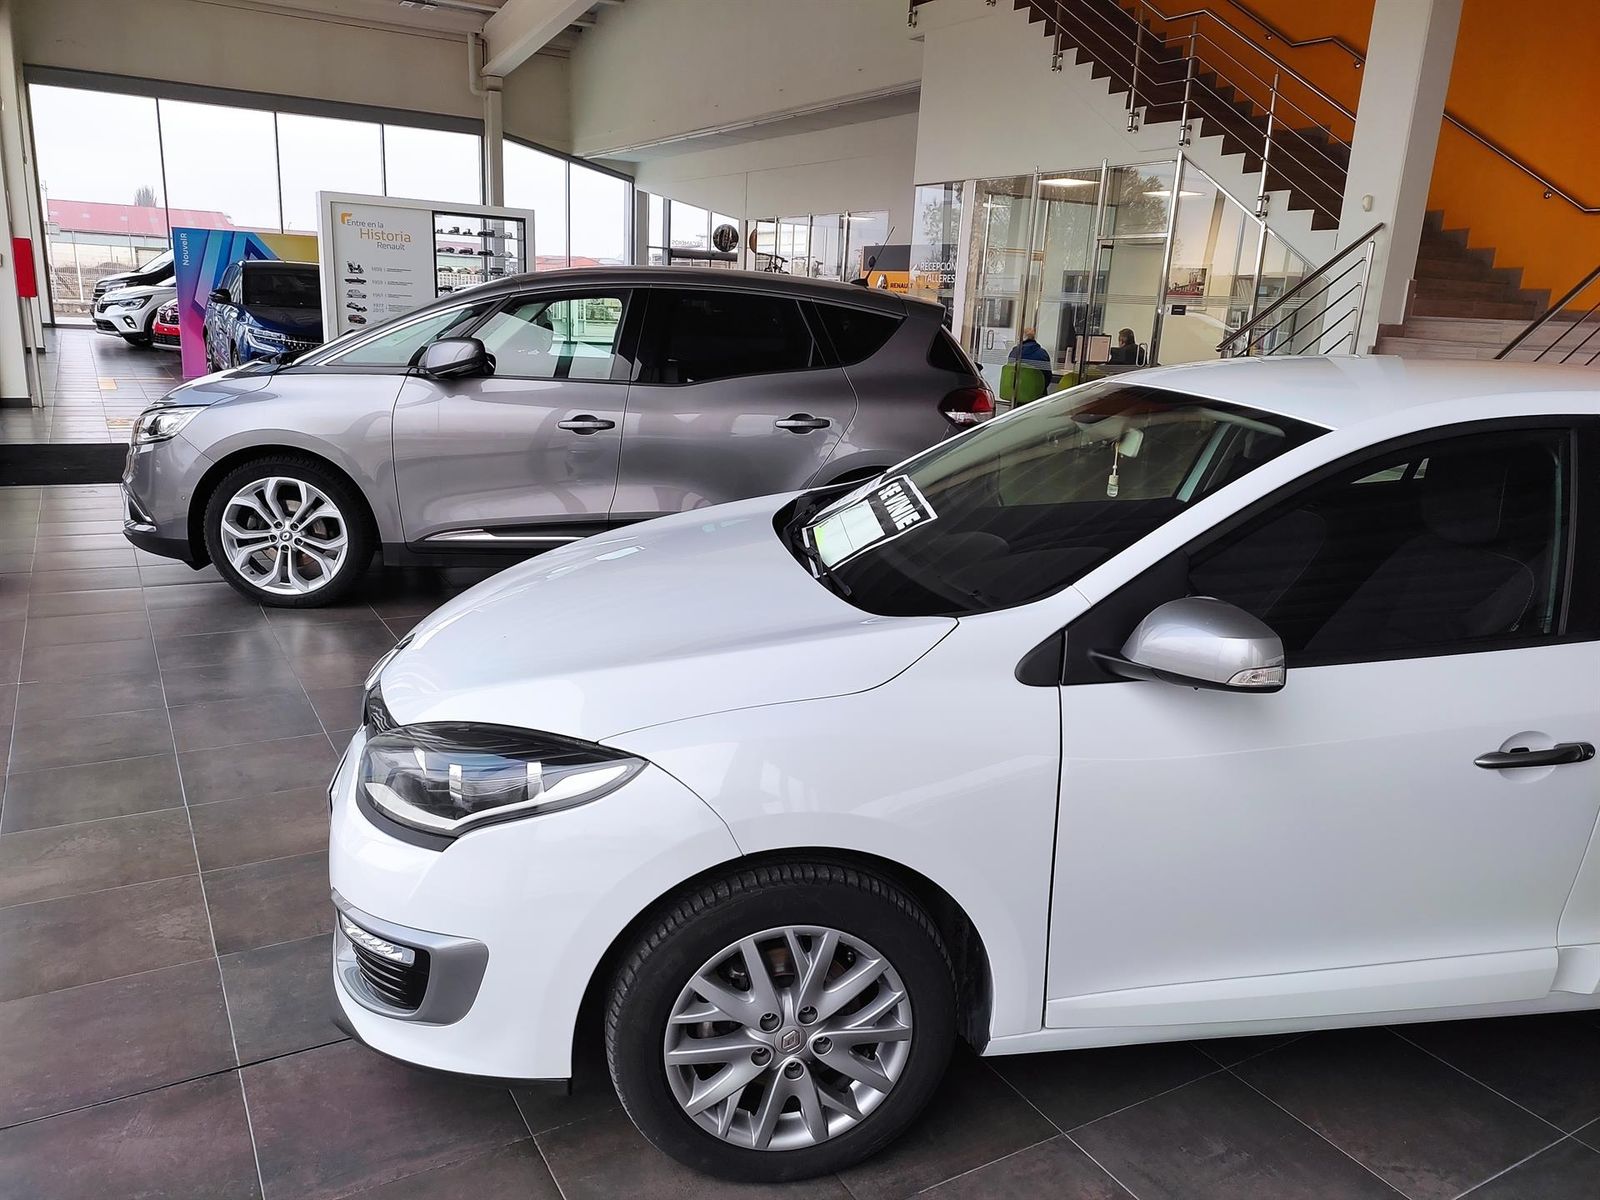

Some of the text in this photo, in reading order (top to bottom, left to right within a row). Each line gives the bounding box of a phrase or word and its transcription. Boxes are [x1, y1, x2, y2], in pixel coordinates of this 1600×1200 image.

[347, 219, 366, 228] Entre
[377, 221, 384, 229] la
[360, 228, 411, 243] Historia
[377, 241, 405, 251] Renault
[924, 274, 955, 284] TALLERES
[877, 482, 903, 501] SE
